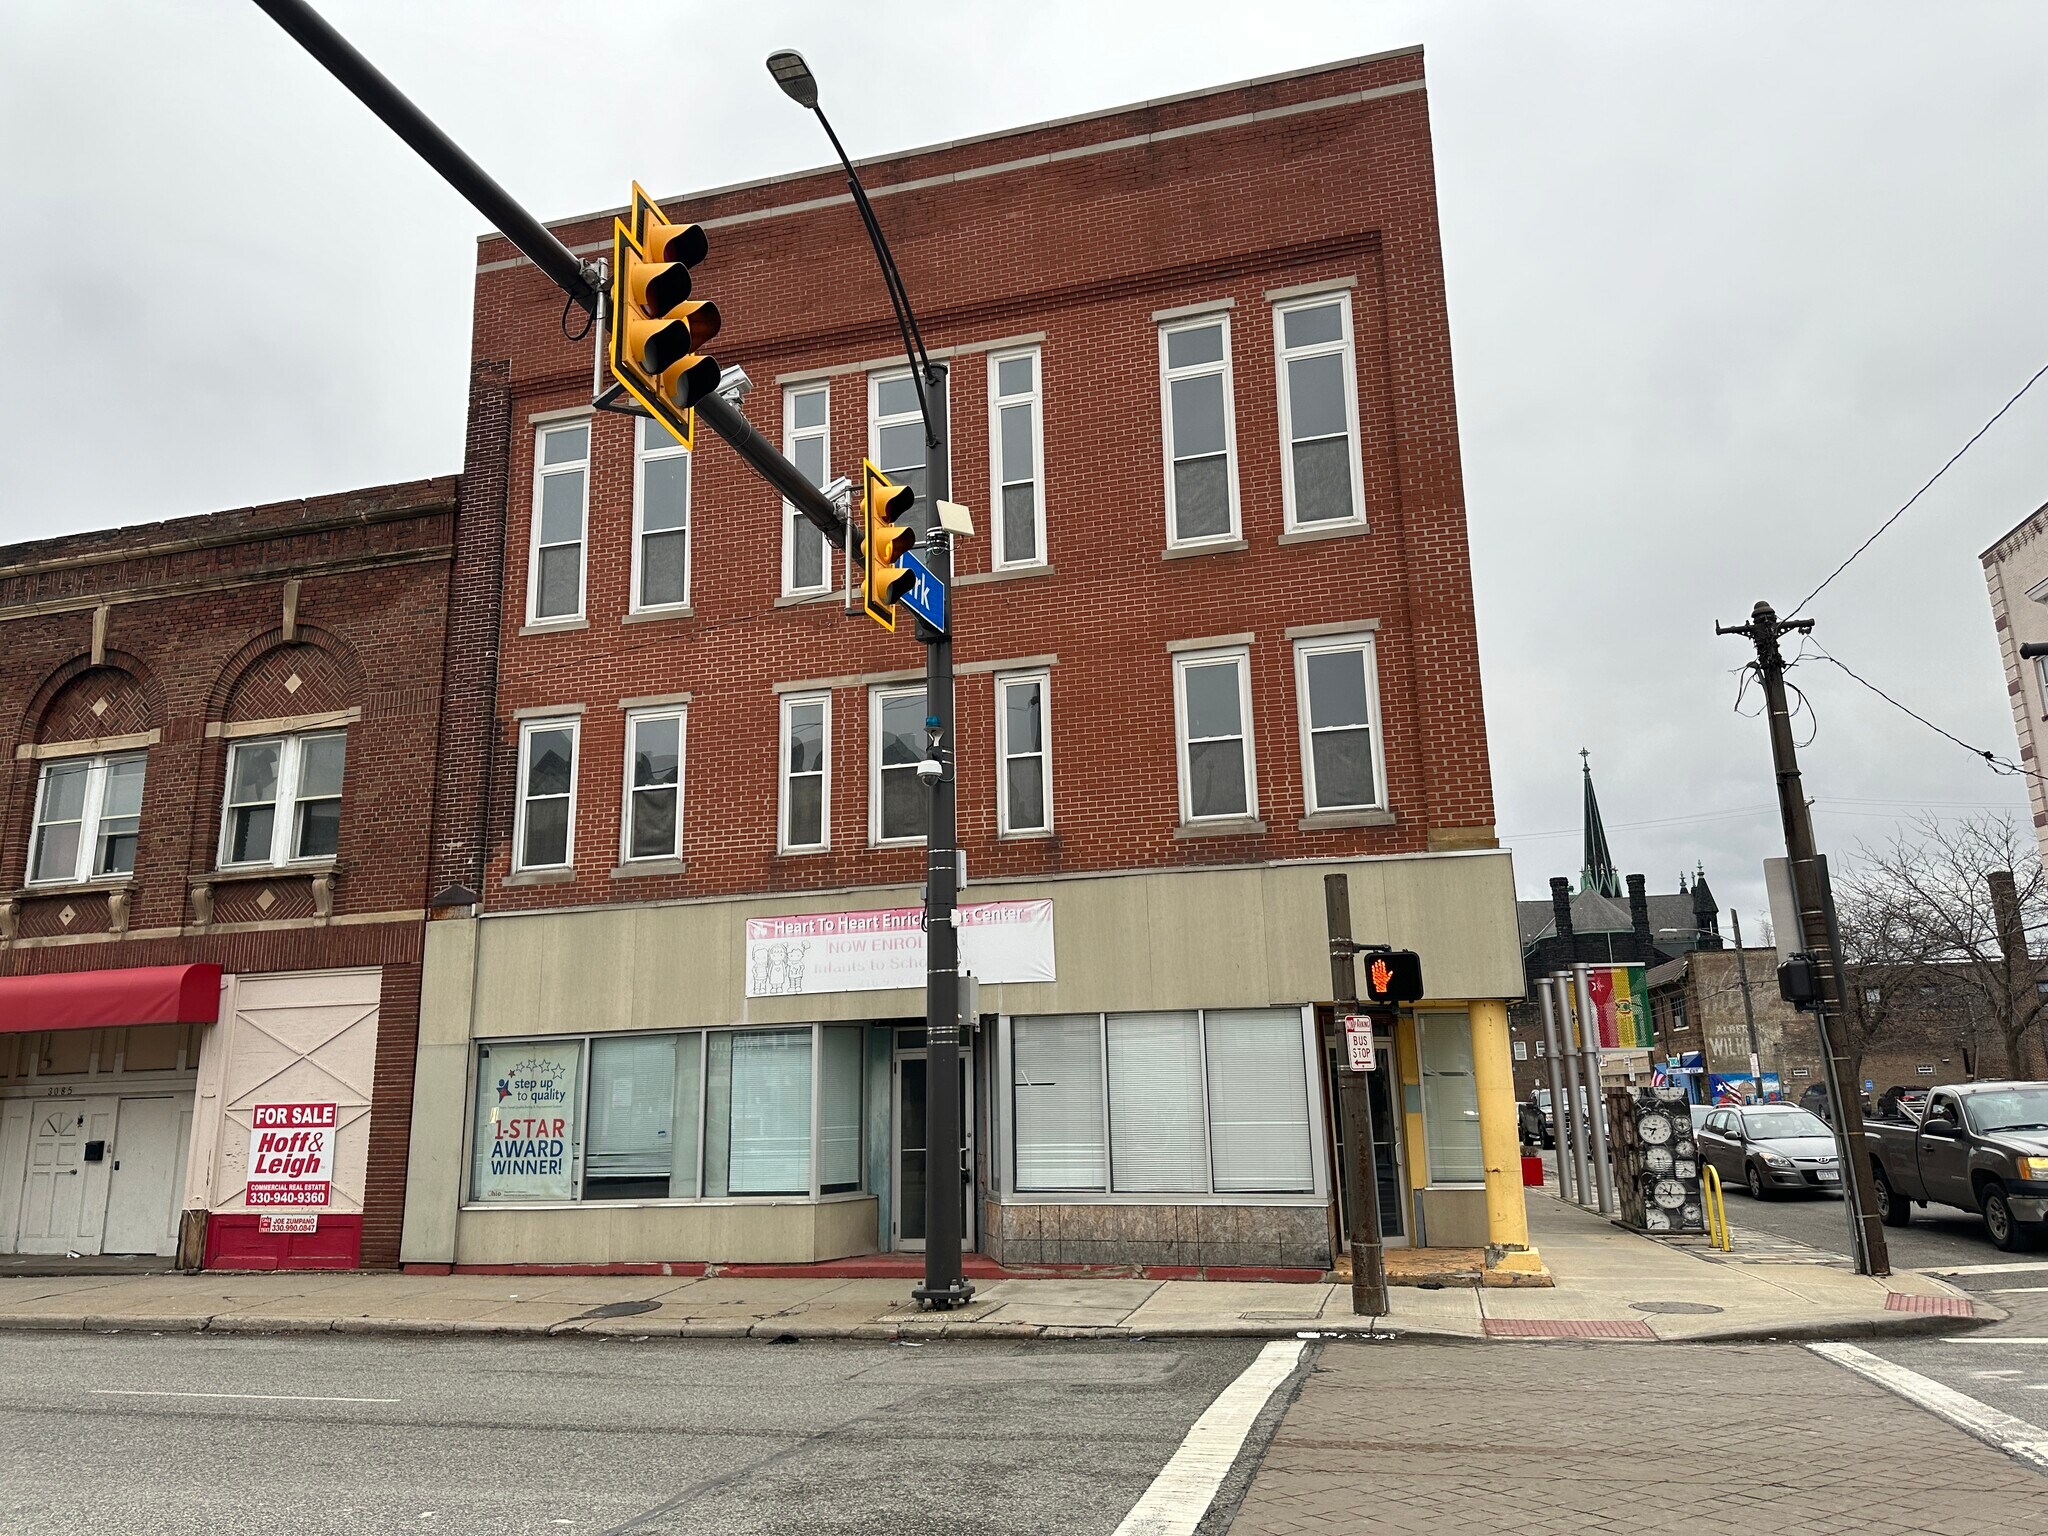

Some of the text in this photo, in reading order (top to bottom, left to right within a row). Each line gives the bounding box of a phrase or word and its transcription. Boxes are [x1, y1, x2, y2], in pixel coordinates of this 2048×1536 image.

[774, 919, 815, 935] Heart
[816, 917, 835, 932] To
[837, 914, 880, 931] Heart
[973, 907, 1024, 923] Center
[829, 939, 867, 954] NOW
[1353, 1035, 1368, 1046] BUS
[1352, 1047, 1371, 1059] STOP
[47, 1086, 73, 1096] 3085
[514, 1079, 553, 1091] step up
[517, 1088, 566, 1103] to quality
[255, 1106, 334, 1125] FOR SALE
[494, 1118, 566, 1140] 1-STAR
[257, 1131, 324, 1153] Hoff&
[491, 1139, 564, 1158] AWARD
[254, 1153, 321, 1179] Leigh
[490, 1158, 562, 1175] WINNER!
[288, 1183, 303, 1191] REAL
[304, 1183, 326, 1191] ESTATE
[249, 1192, 325, 1204] 330-940-9360
[271, 1224, 315, 1232] 330.990.0847
[273, 1217, 315, 1225] JOE ZUMPANO
